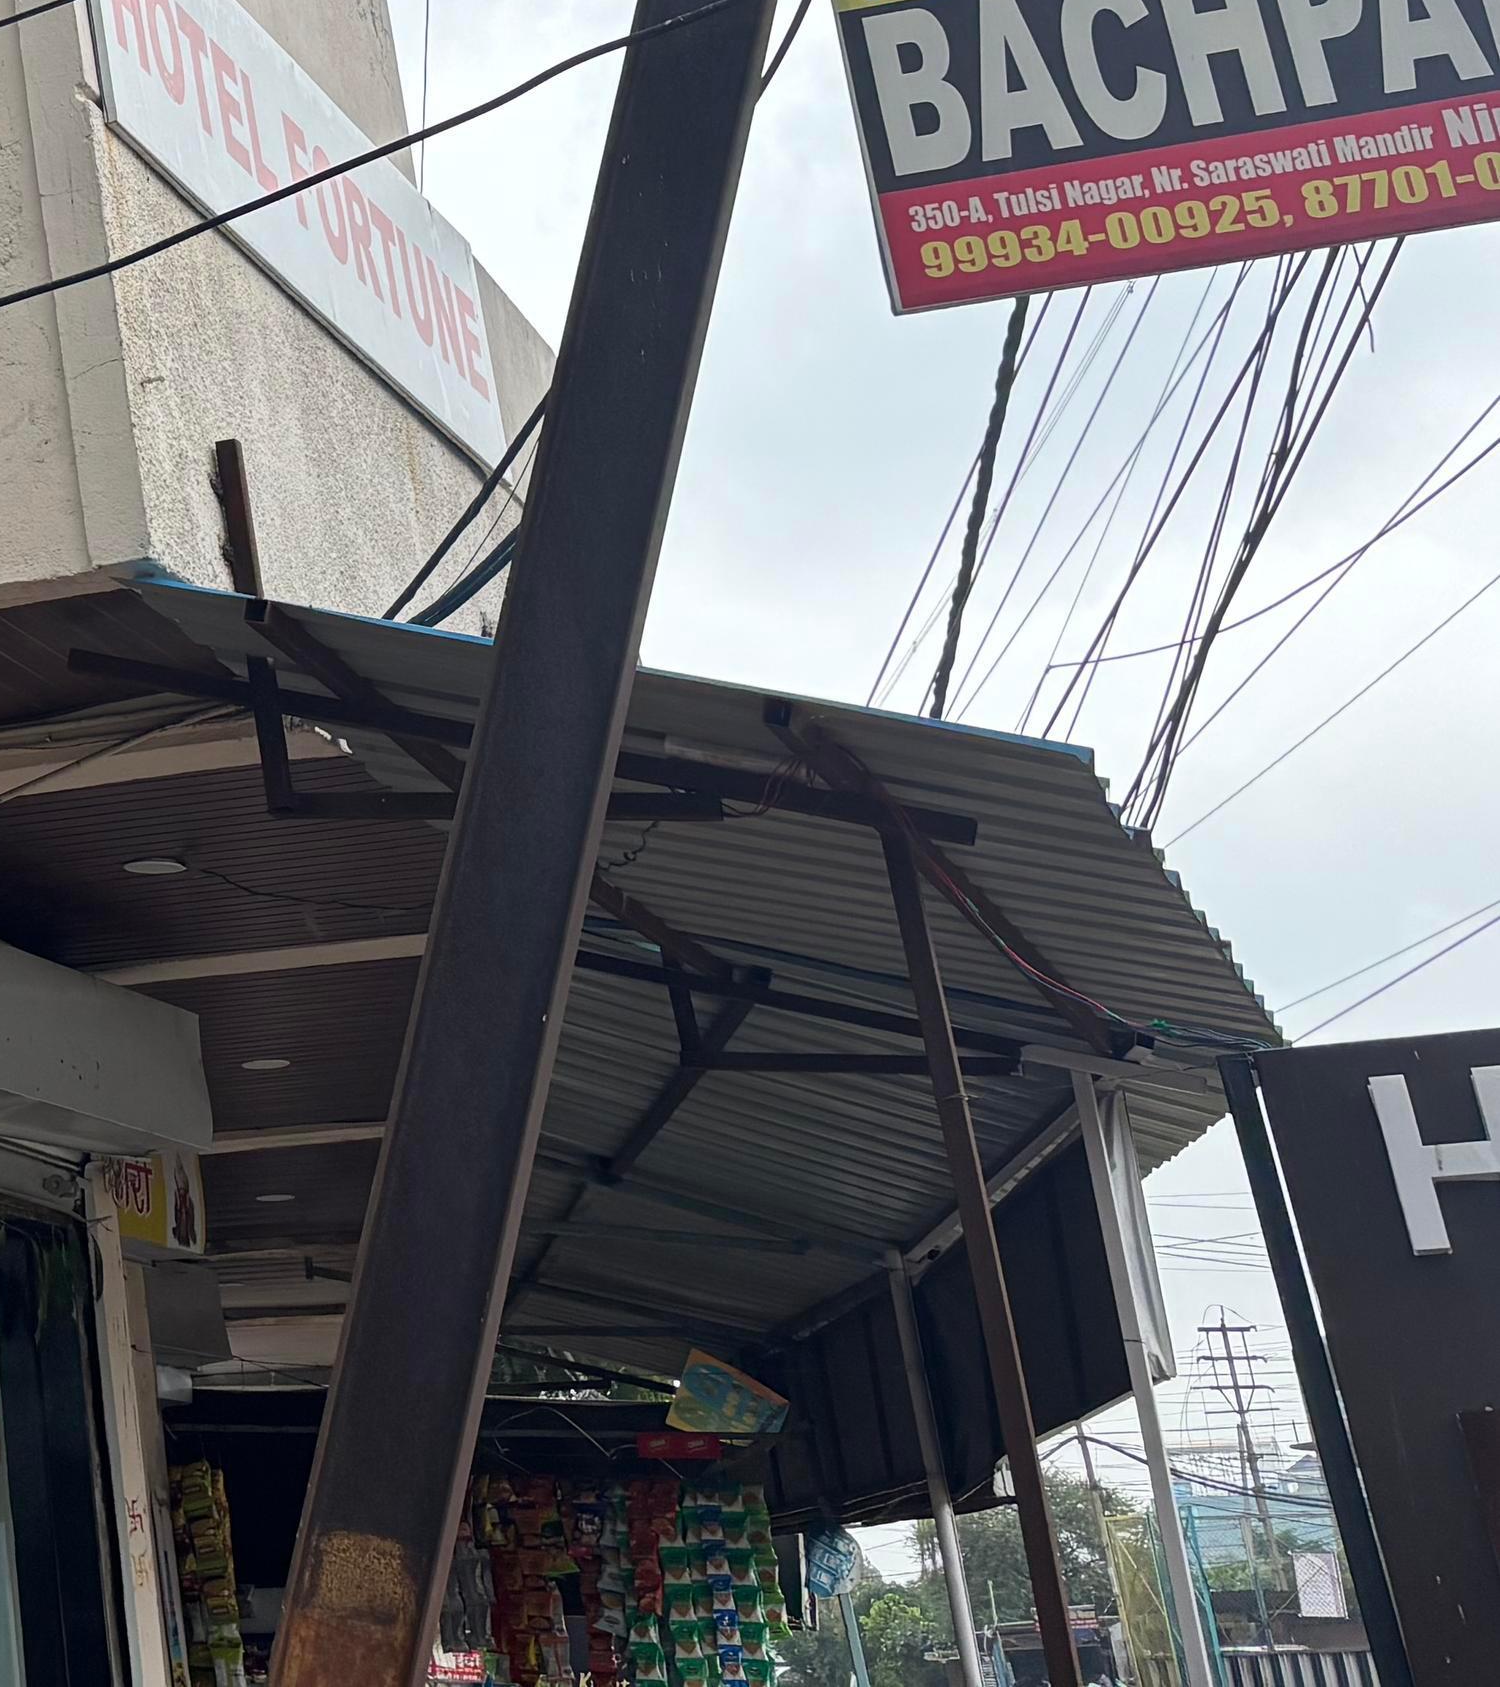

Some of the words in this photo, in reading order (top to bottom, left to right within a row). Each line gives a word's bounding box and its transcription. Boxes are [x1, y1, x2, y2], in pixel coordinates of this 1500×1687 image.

[908, 196, 993, 232] 350-A,
[993, 183, 1063, 218] Tulsi
[1063, 173, 1150, 205] Nagar,
[1151, 165, 1189, 194] Nr.
[1189, 139, 1332, 188] Saraswati
[1333, 124, 1434, 163] Mandir
[919, 188, 1294, 278] 99934-00925,
[1301, 151, 1500, 219] 87701-0
[280, 110, 491, 404] FORTUNE
